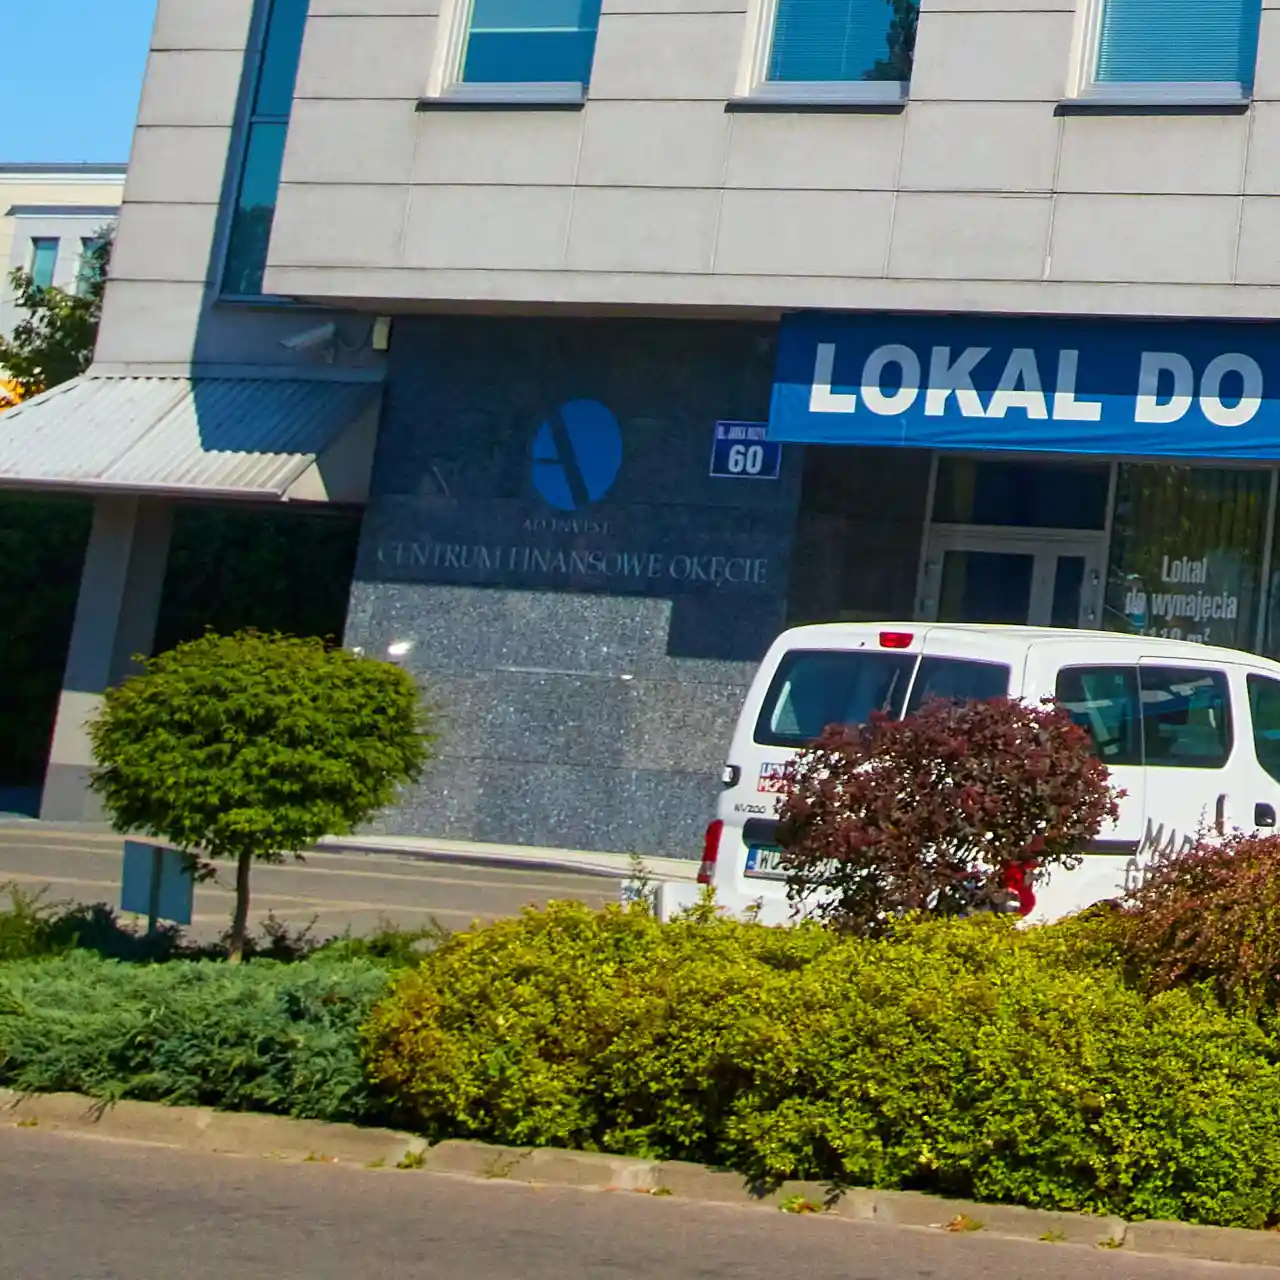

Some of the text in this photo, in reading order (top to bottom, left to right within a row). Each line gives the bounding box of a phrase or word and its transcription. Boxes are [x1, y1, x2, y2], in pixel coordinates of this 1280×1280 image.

[806, 342, 1103, 421] LOKAL
[1133, 351, 1263, 427] DO
[728, 444, 763, 474] 60
[508, 547, 663, 578] FINANSOWE
[669, 553, 769, 587] OKĘCIE
[1161, 555, 1208, 583] Lokal
[1151, 590, 1238, 622] wynajęcia
